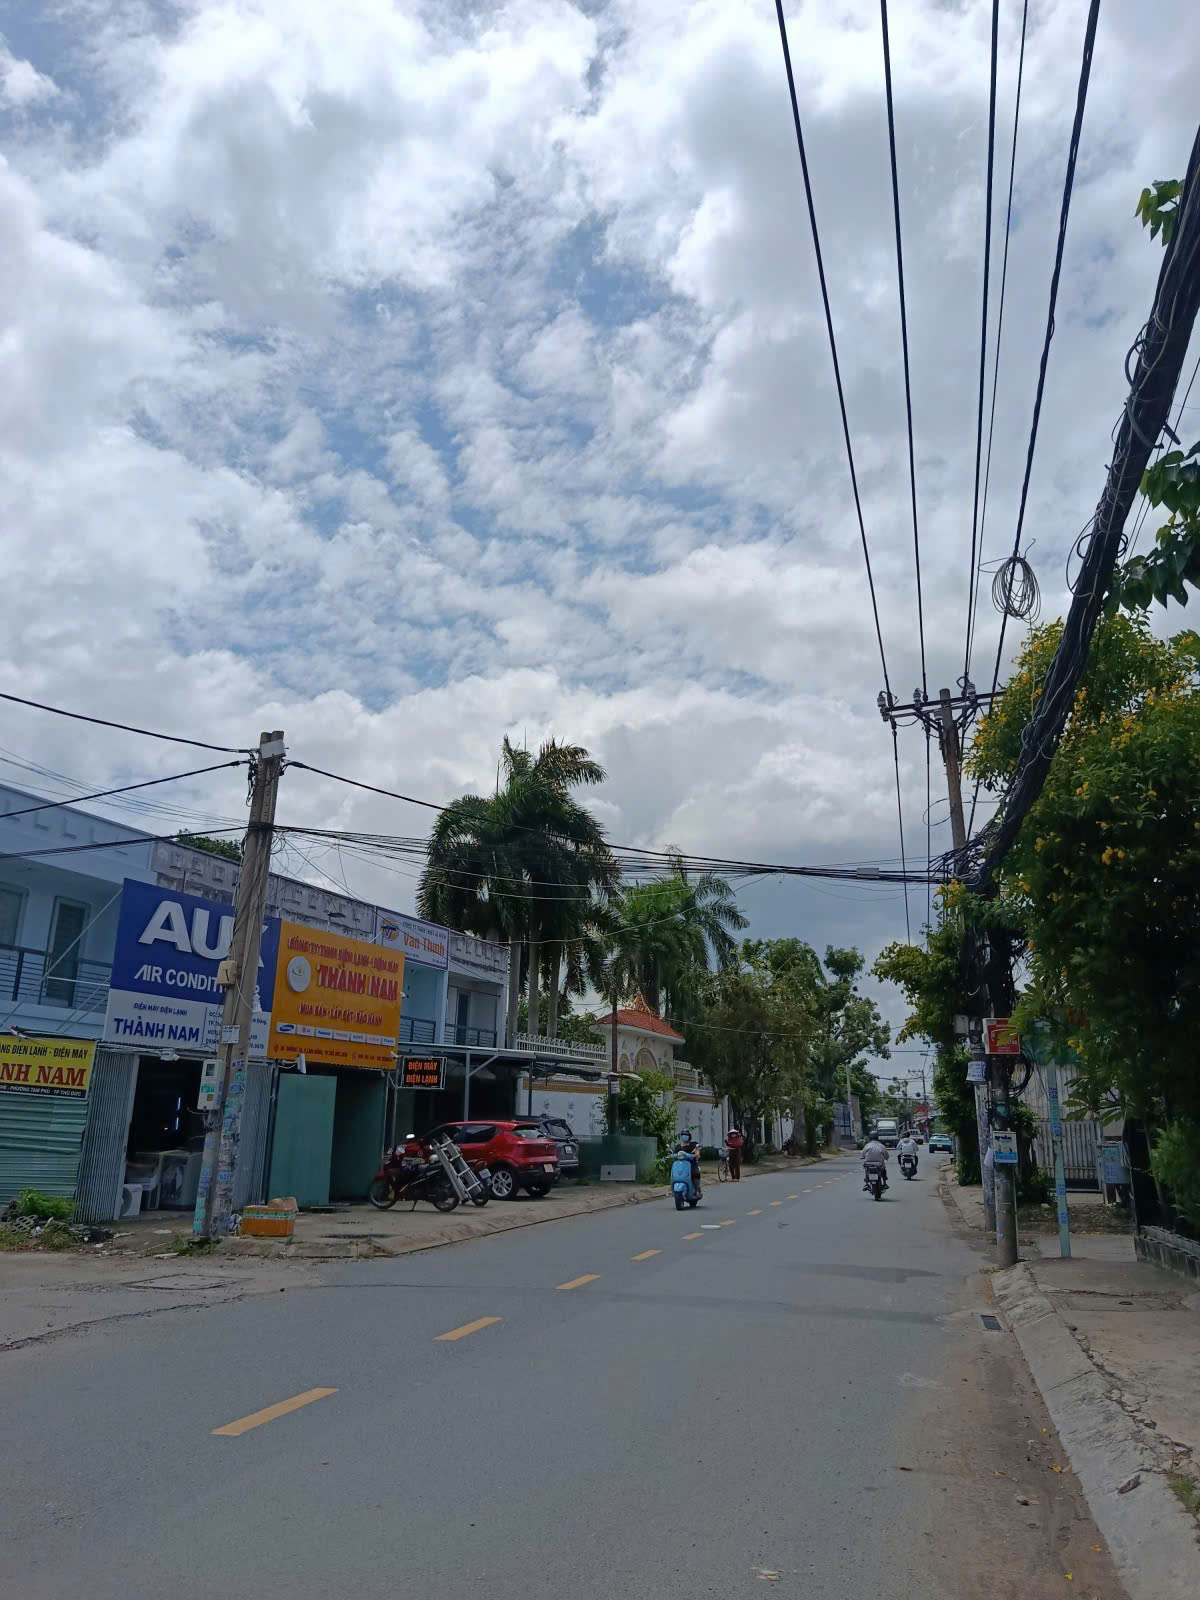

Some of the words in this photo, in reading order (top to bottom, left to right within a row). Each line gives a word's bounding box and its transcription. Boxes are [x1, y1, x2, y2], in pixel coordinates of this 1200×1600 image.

[134, 964, 162, 983] AIR
[317, 961, 366, 994] THÀNH
[367, 975, 397, 1000] NAM
[114, 1016, 165, 1038] THÀNH
[168, 1025, 200, 1042] NAM
[12, 1044, 28, 1057] ĐIỆN
[30, 1046, 48, 1058] LẠNH
[53, 1048, 71, 1060] ĐIỆN
[72, 1049, 89, 1059] MÁY
[408, 1060, 423, 1071] ĐIỆN
[423, 1061, 438, 1071] MÁY
[35, 1065, 87, 1086] NAM
[406, 1073, 421, 1084] ĐIỆN
[421, 1075, 438, 1085] LẠNH
